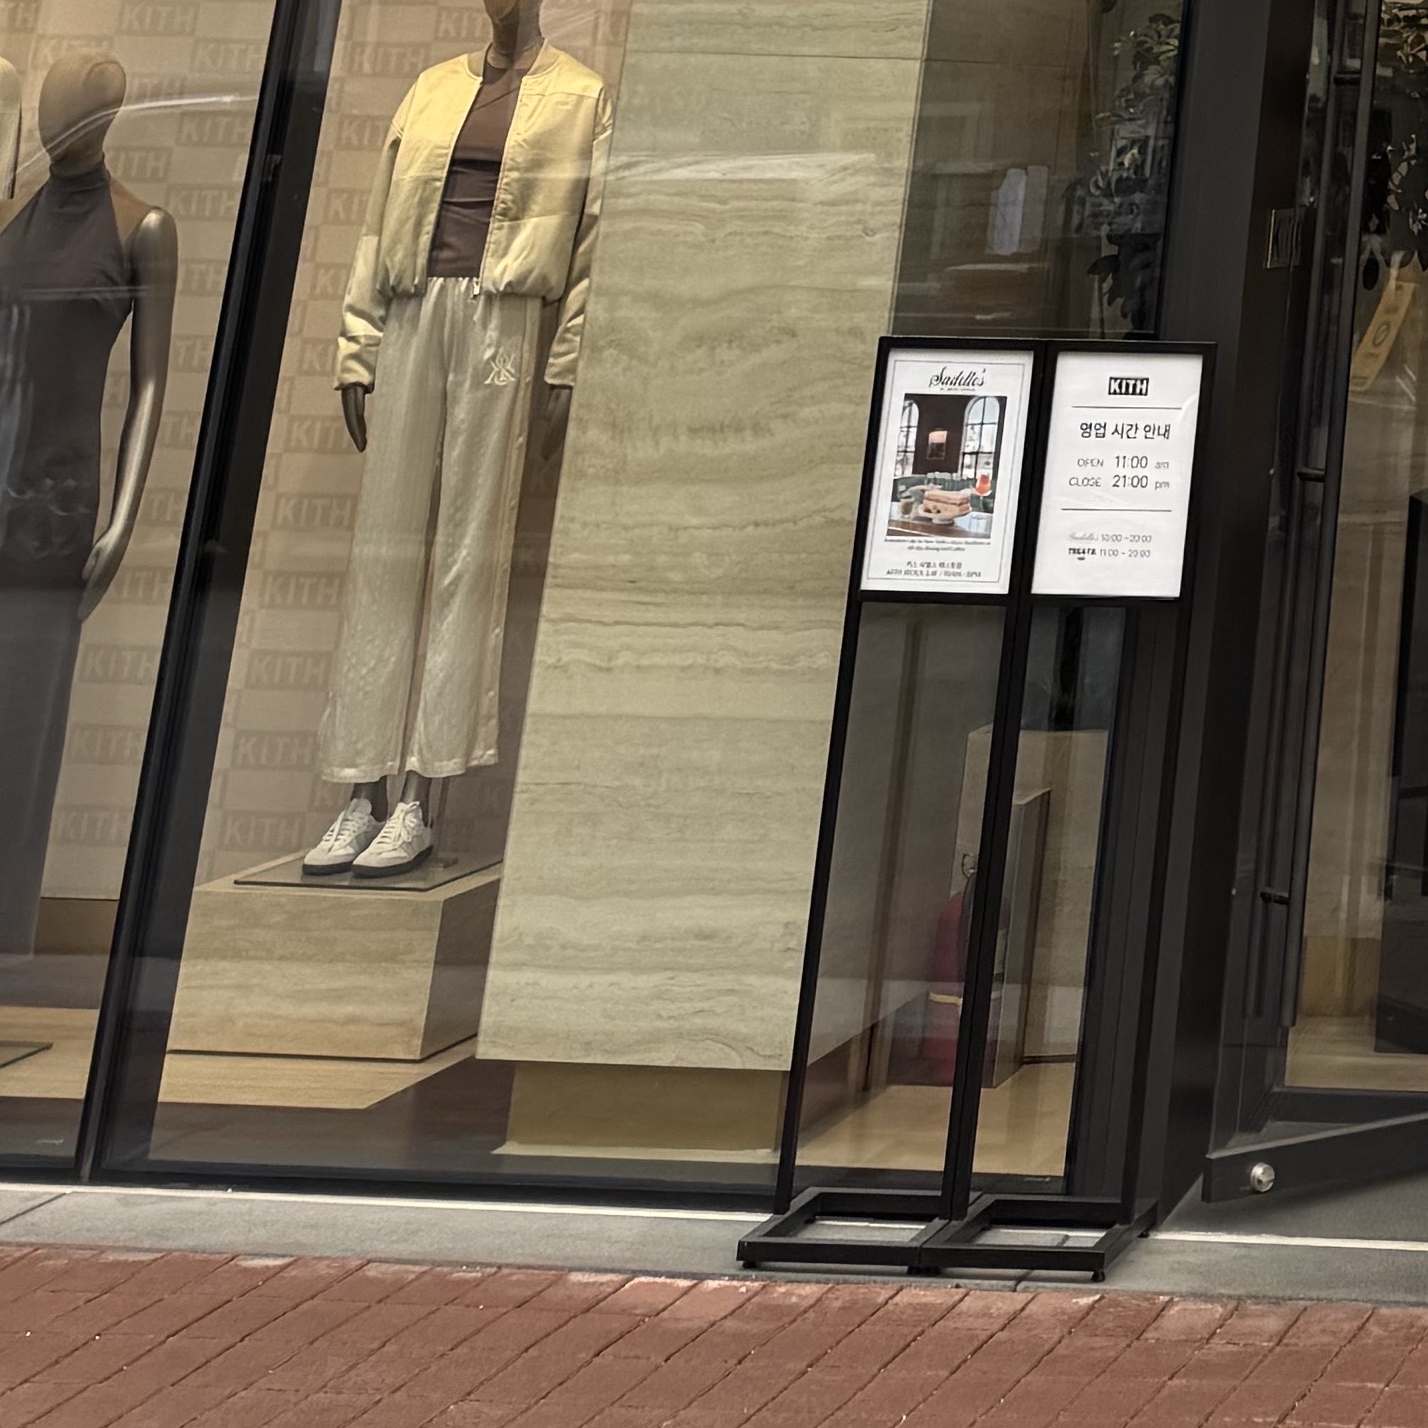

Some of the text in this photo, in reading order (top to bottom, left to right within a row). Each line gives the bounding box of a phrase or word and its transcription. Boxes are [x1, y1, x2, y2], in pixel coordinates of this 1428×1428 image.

[1109, 378, 1148, 395] KITH
[1080, 422, 1171, 440] 영업 시간 안내
[1077, 458, 1104, 467] OPEN
[1115, 455, 1148, 469] 11:00
[1068, 476, 1102, 488] CLOSE
[1112, 474, 1148, 488] 21:00
[278, 498, 352, 529] KITH
[265, 576, 340, 608] KITH
